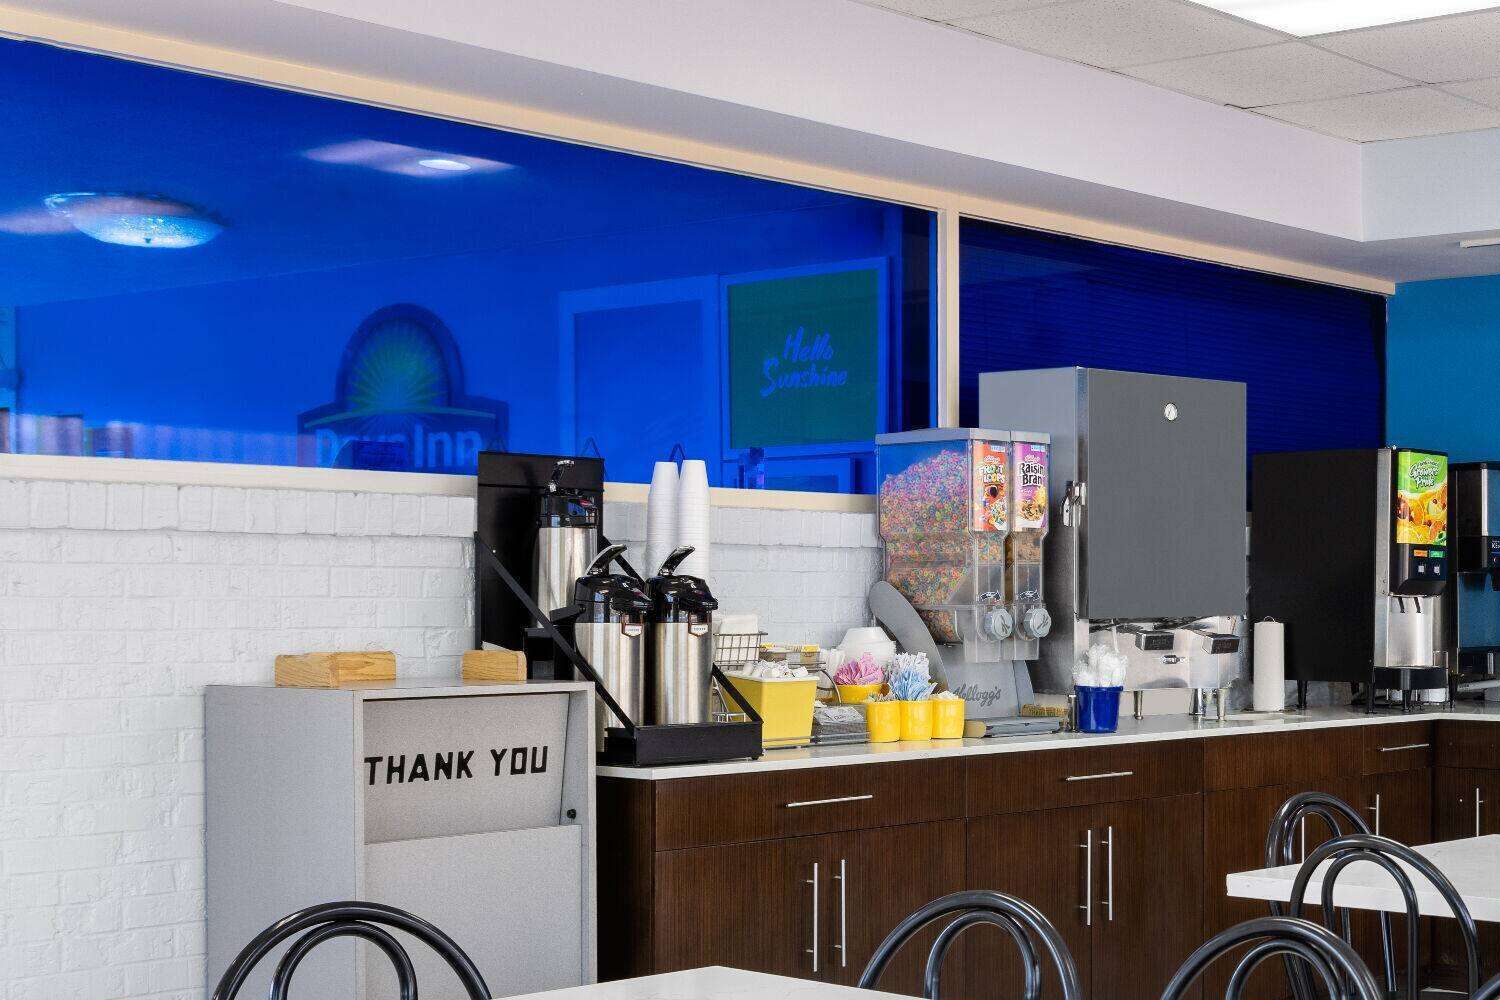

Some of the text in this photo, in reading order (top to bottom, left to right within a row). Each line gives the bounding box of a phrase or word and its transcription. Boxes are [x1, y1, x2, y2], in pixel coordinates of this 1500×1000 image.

[782, 326, 833, 362] Hello
[760, 357, 848, 397] Sunshine
[413, 423, 483, 468] Inn
[1019, 462, 1045, 475] Raisin
[1021, 473, 1044, 486] Bran
[364, 745, 548, 786] THANK YOU
